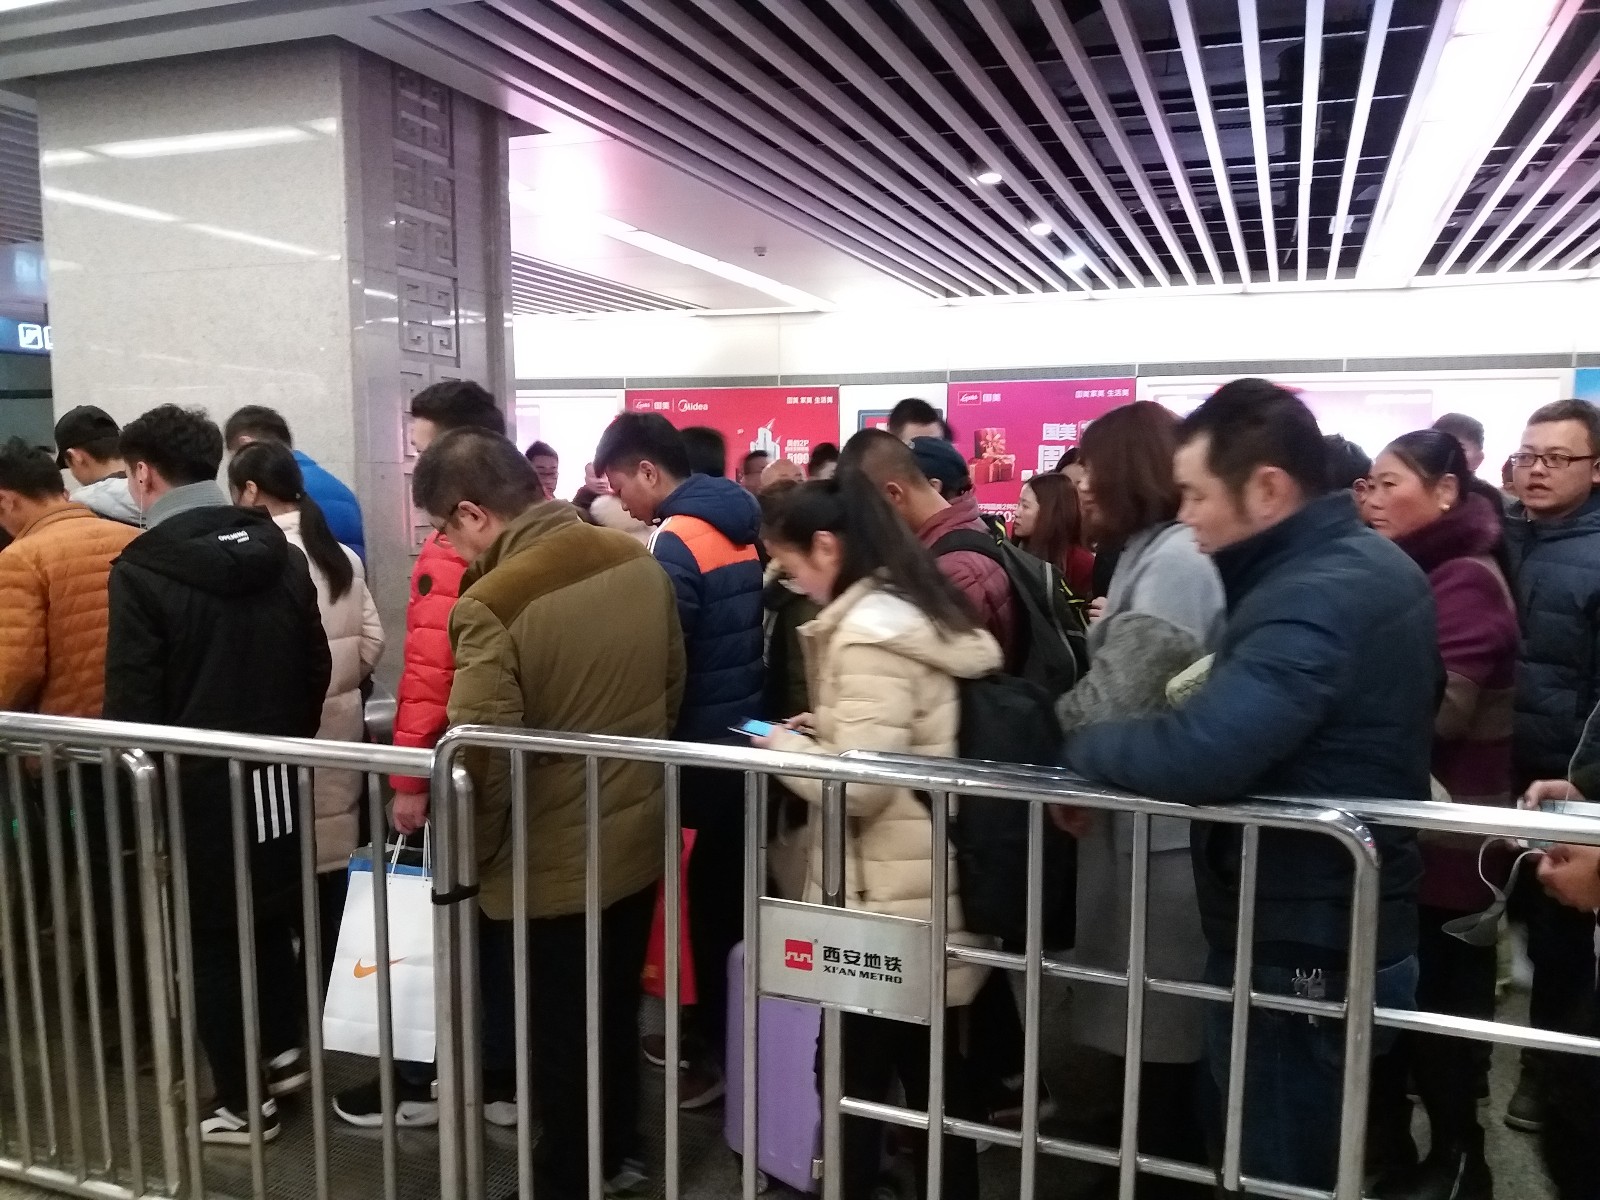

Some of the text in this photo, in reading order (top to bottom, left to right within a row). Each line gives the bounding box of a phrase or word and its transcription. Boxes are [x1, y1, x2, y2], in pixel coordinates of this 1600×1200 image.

[680, 400, 708, 411] Midea
[1043, 423, 1077, 440] 国美
[823, 946, 902, 973] 西安地铁
[823, 965, 903, 984] XI'AN METRO
